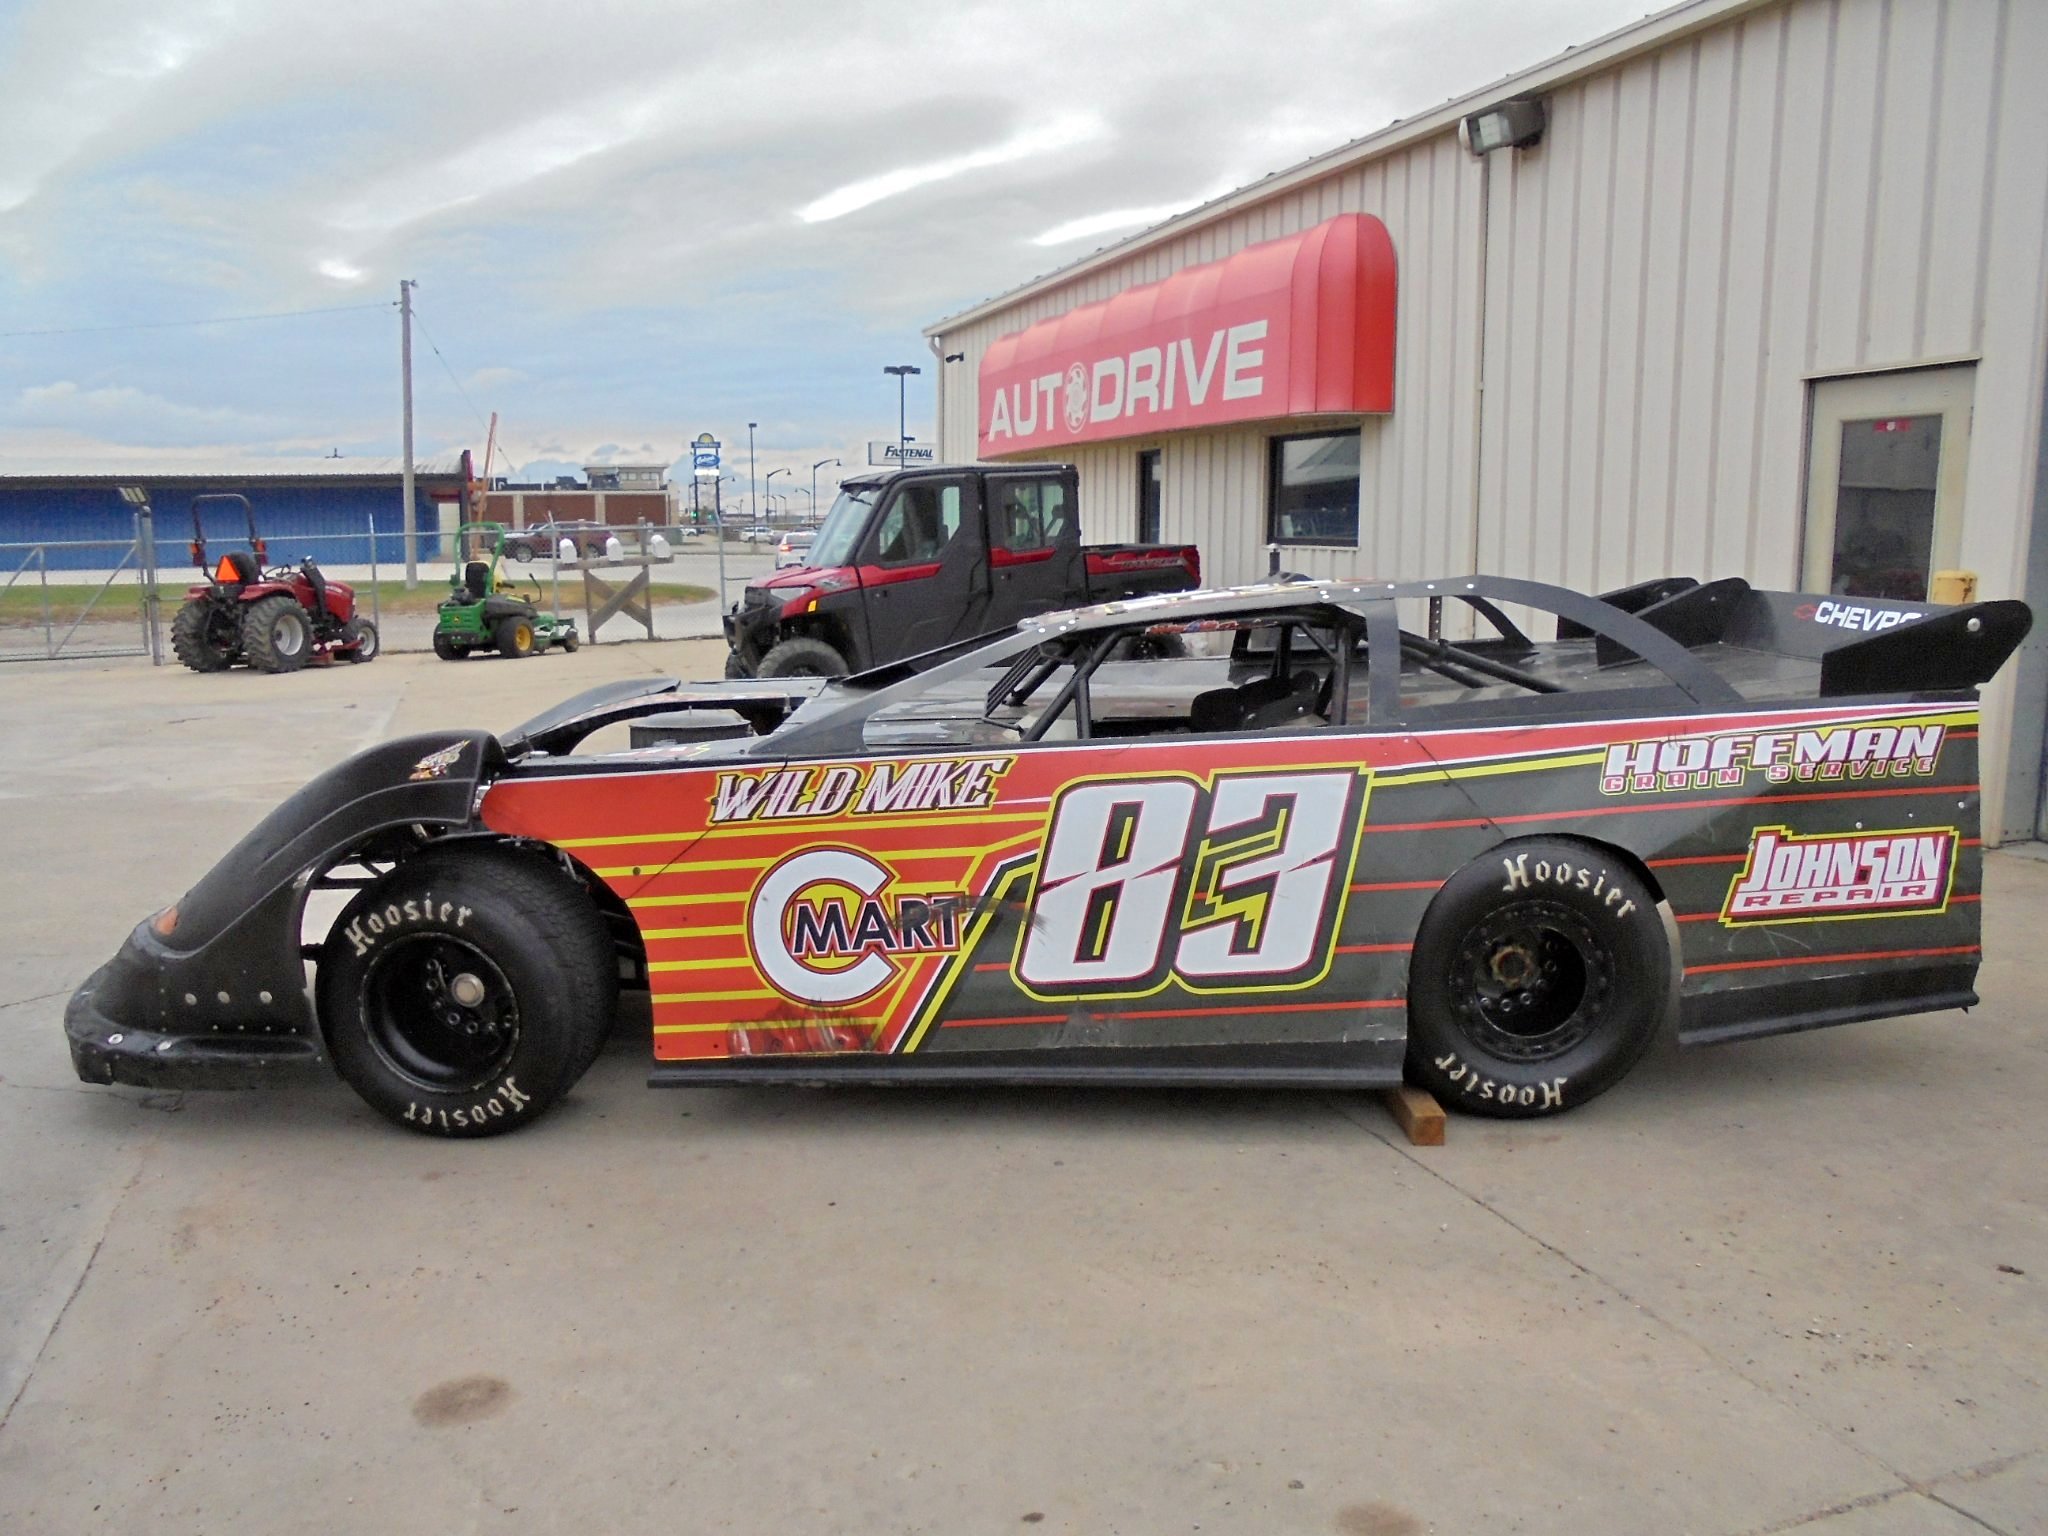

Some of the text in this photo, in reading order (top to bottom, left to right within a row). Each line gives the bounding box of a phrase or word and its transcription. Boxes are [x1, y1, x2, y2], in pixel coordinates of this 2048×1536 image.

[1603, 755, 1933, 793] GRAIN SERVICE
[1605, 726, 1946, 776] HOFFMAN
[711, 757, 1014, 823] WILD MIKE
[1018, 770, 1360, 988] 83
[1503, 853, 1636, 918] Hoosier
[1738, 834, 1945, 892] JOHNSON
[792, 892, 967, 954] MART
[1743, 882, 1929, 908] REPAIR
[344, 892, 473, 957] Hoosier
[403, 1076, 531, 1131] Hoosier
[1434, 1052, 1568, 1110] Hoosier
